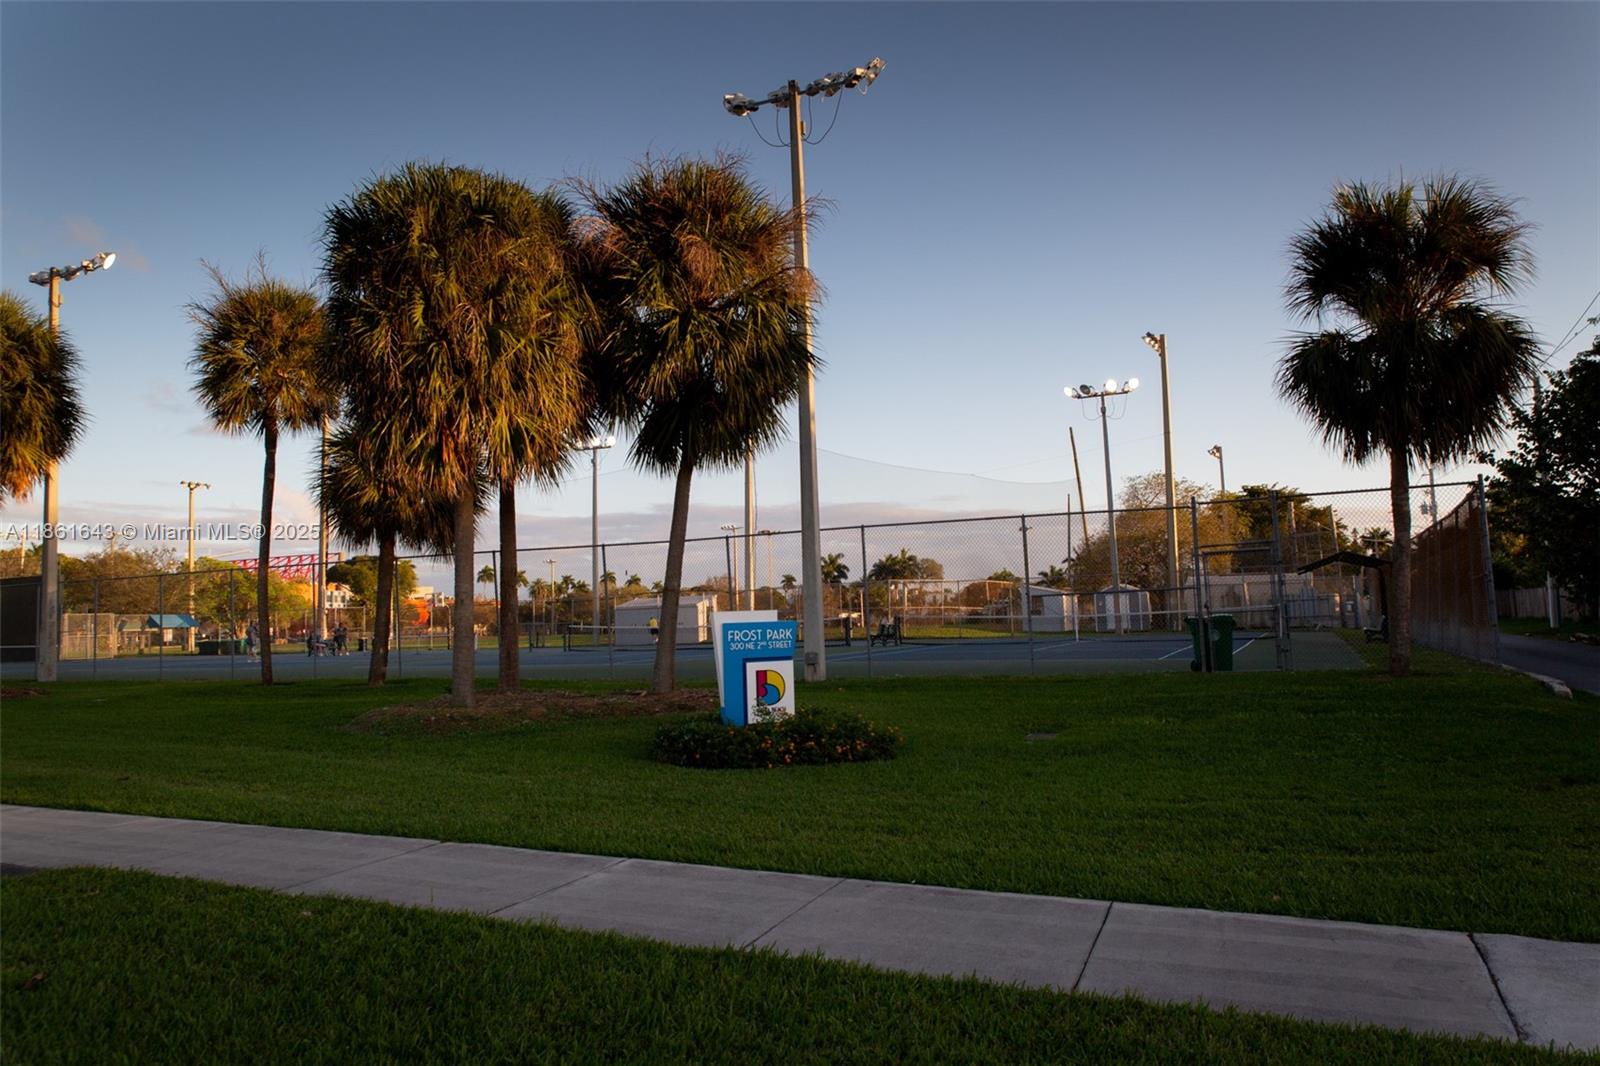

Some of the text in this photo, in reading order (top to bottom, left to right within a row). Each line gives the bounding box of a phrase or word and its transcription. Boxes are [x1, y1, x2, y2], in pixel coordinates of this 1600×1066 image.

[727, 628, 793, 642] FROST PARK
[729, 642, 744, 651] 300
[745, 641, 756, 650] NE
[768, 640, 792, 649] STREET
